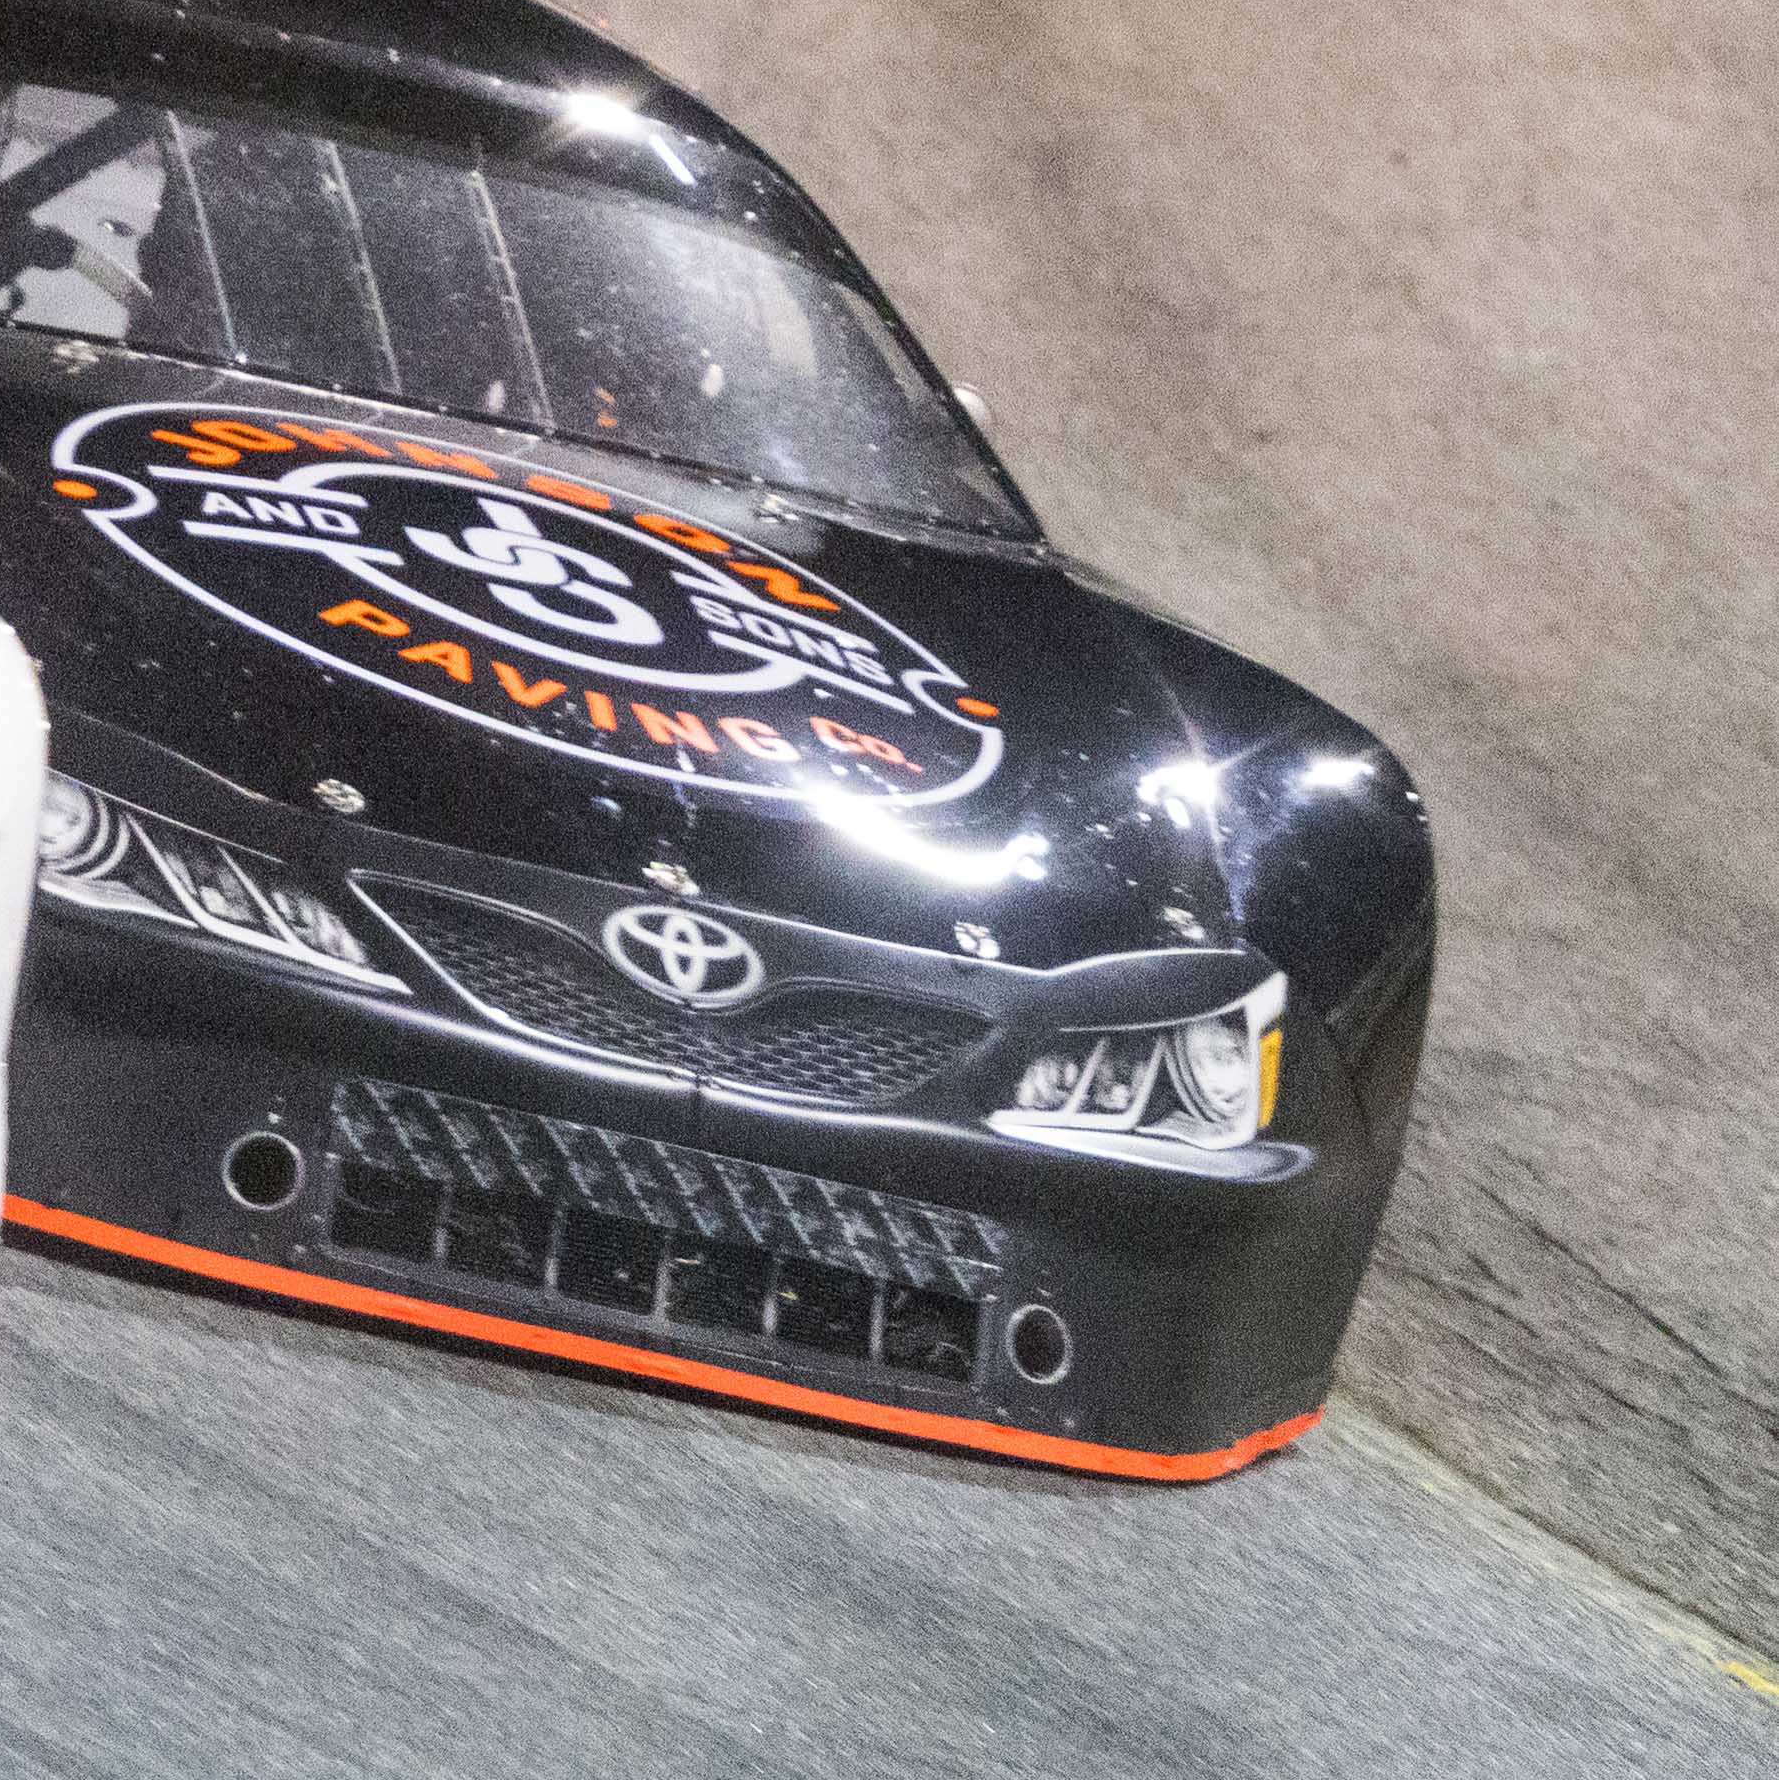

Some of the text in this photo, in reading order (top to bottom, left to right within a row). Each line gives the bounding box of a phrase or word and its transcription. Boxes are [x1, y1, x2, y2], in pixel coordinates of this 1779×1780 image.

[149, 418, 843, 612] JOHNSON
[201, 488, 361, 537] AND
[316, 597, 803, 764] PAVING
[689, 594, 897, 686] SONS
